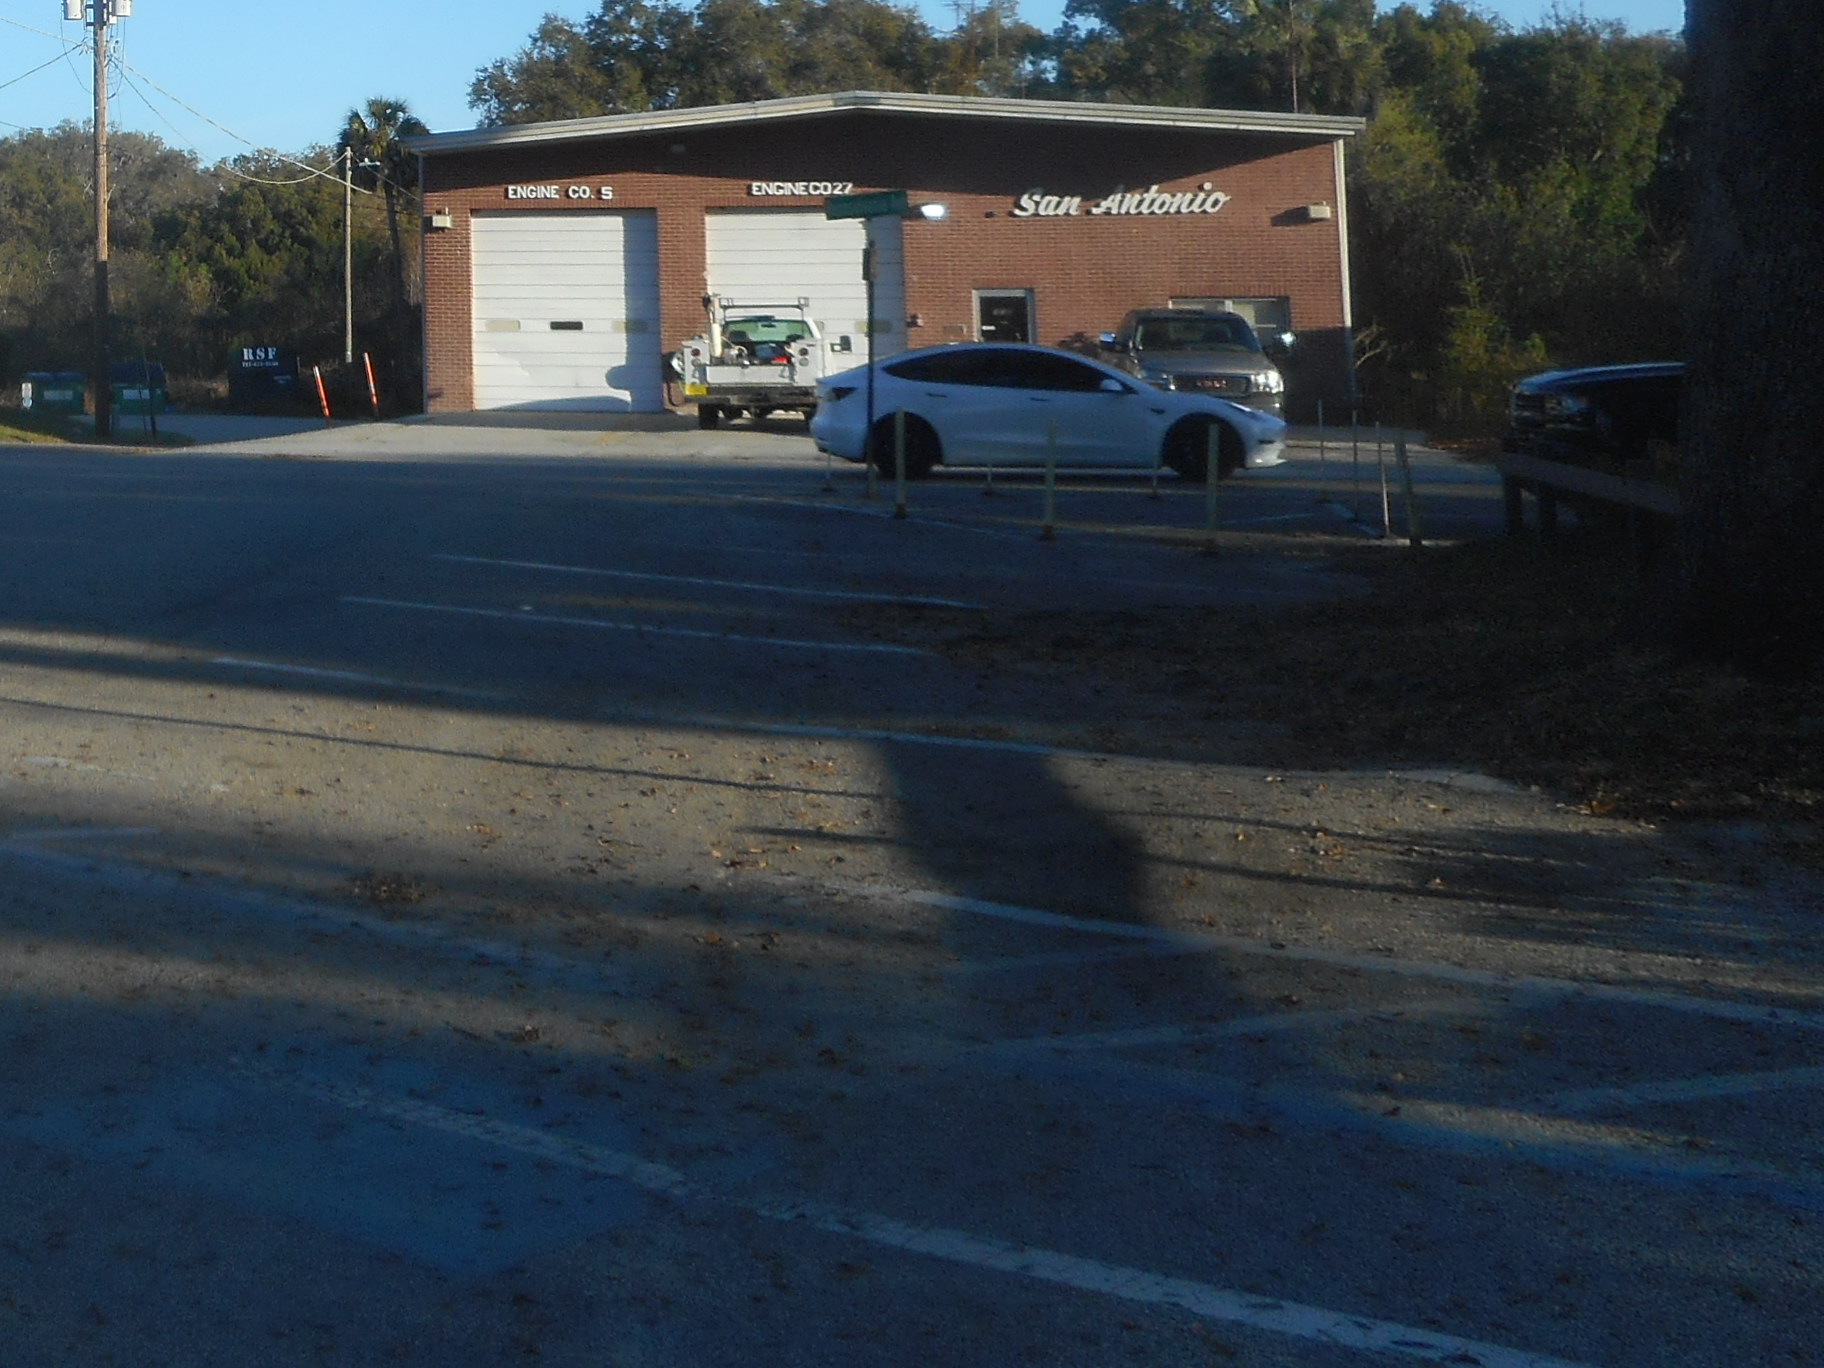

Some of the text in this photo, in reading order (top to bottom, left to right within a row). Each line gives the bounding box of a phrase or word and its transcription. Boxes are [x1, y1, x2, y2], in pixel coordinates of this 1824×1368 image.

[507, 185, 613, 200] ENGINE CO. 5
[751, 182, 808, 195] ENGINE
[1012, 182, 1231, 217] San Antonio
